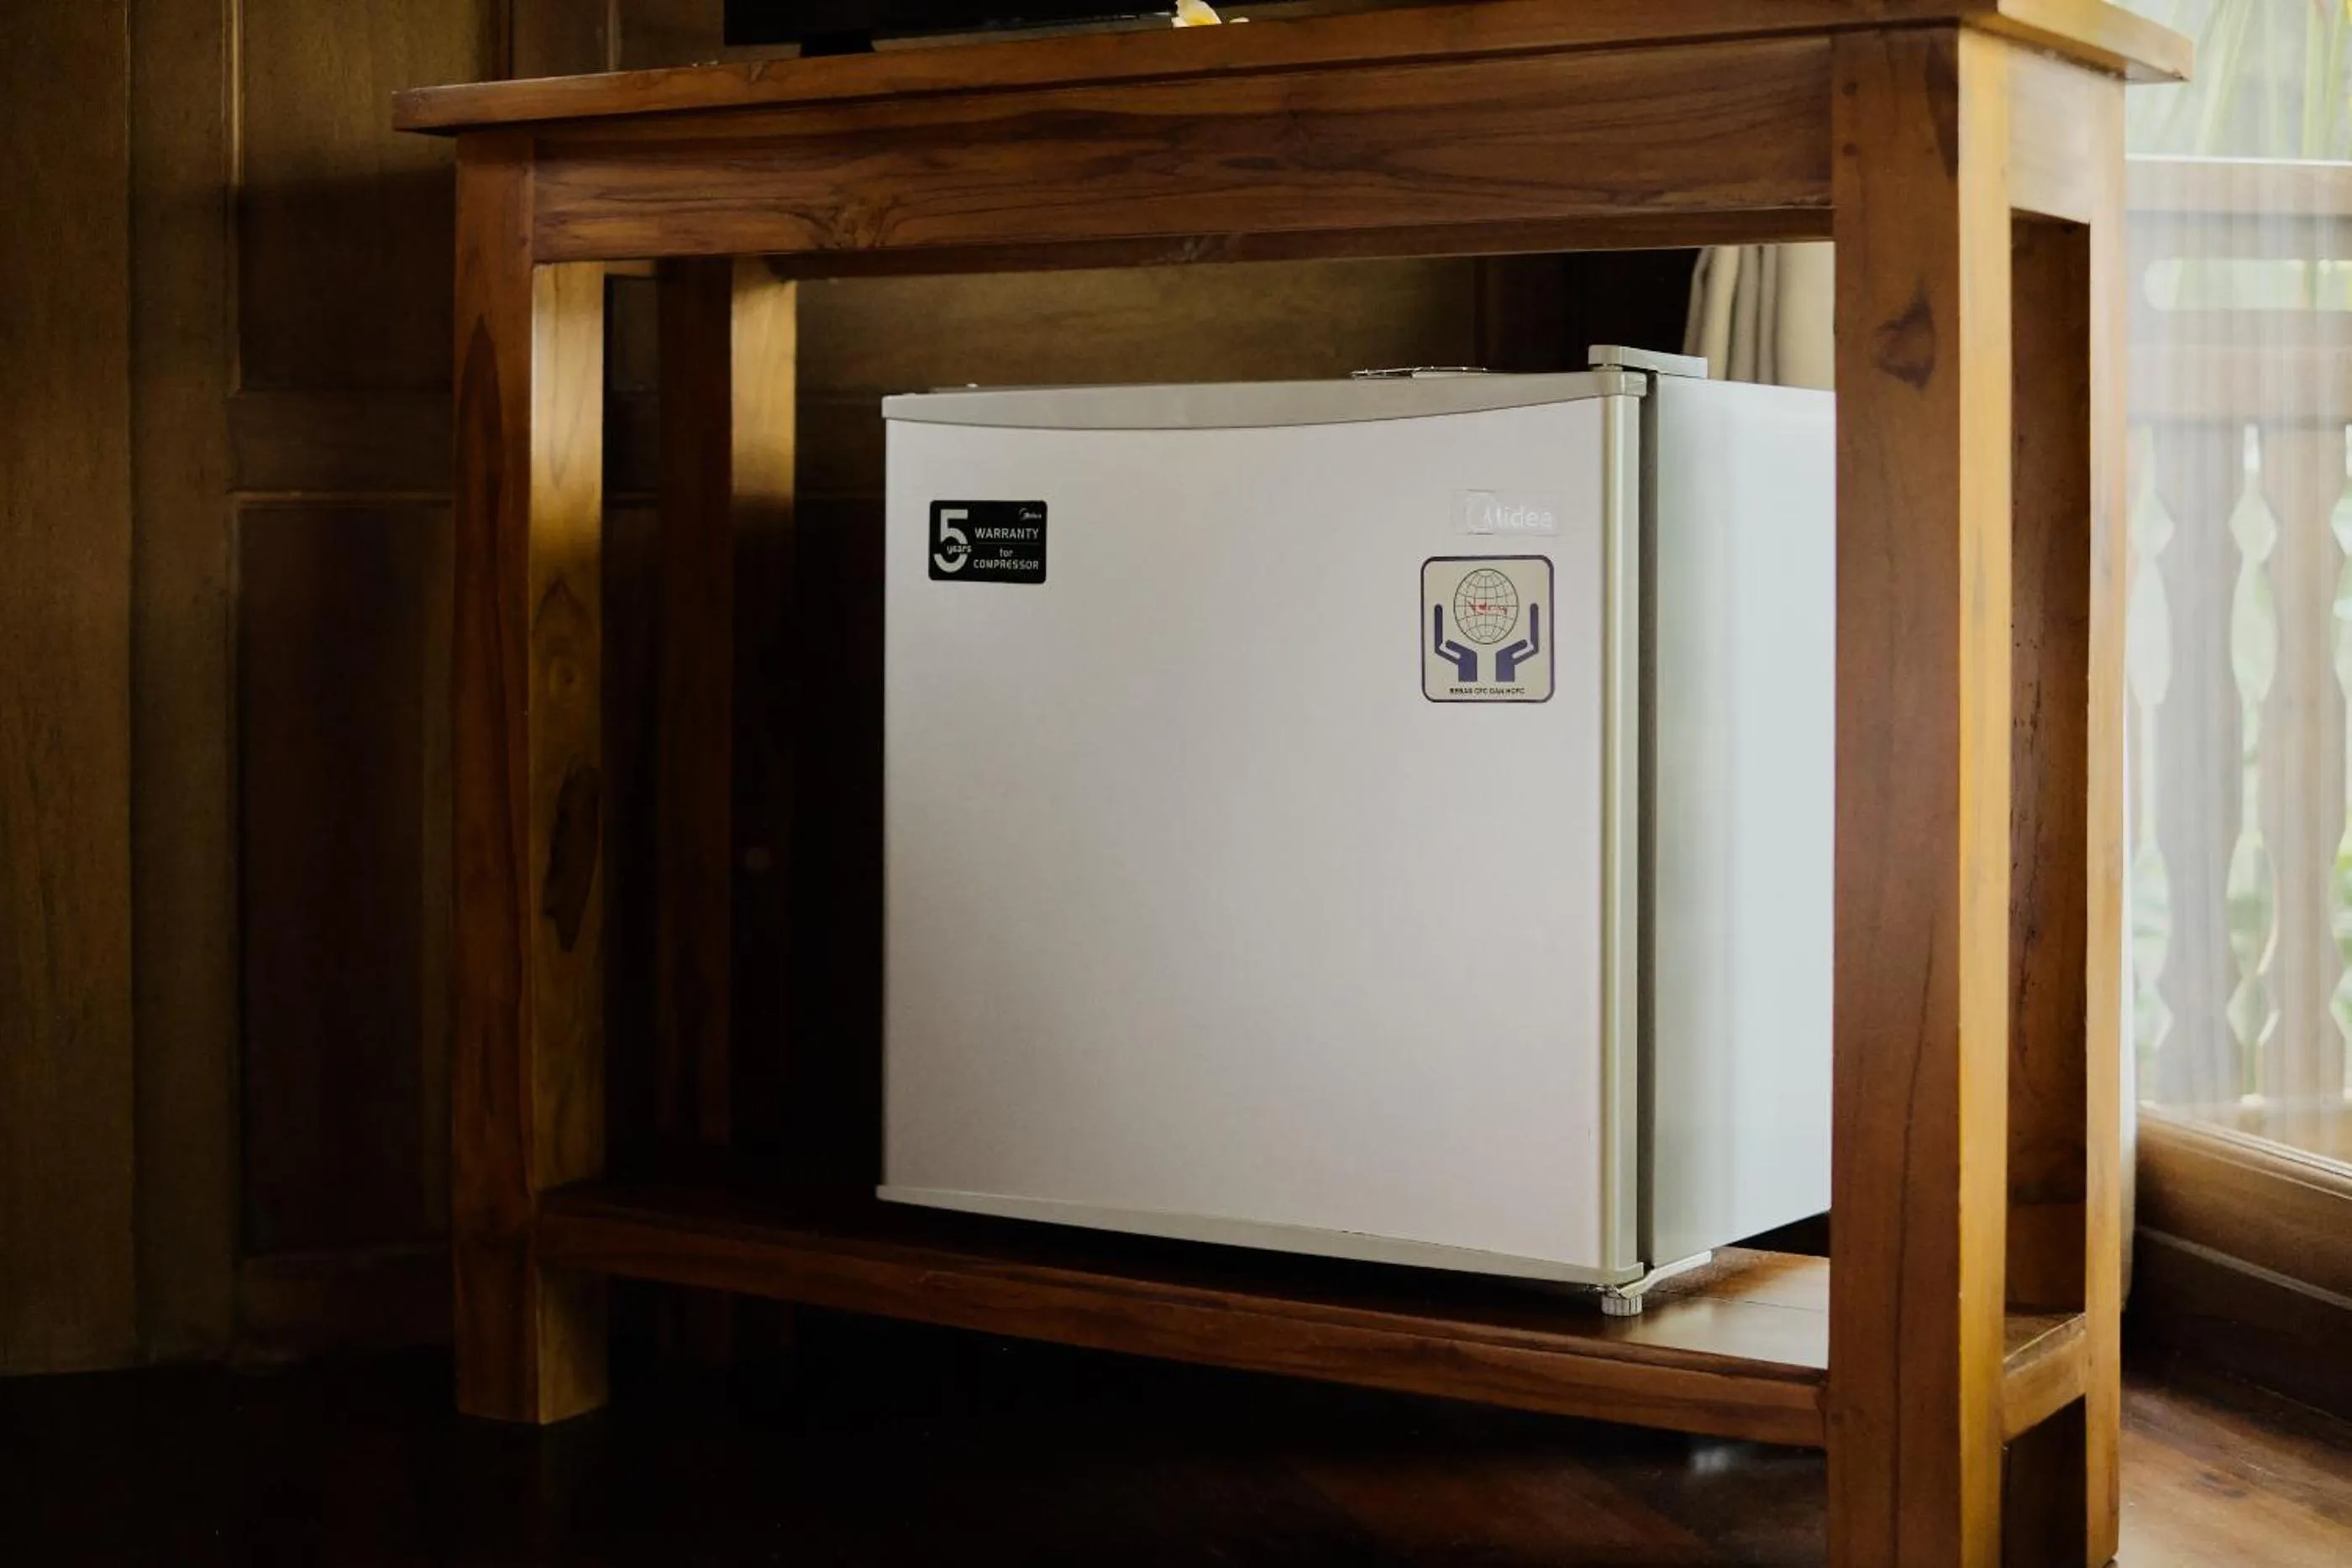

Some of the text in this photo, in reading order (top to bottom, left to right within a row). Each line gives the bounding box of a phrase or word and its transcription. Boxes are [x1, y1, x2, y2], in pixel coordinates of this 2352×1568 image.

[974, 527, 1039, 539] WARRANTY
[933, 509, 969, 573] 5
[947, 545, 972, 554] years
[1000, 548, 1013, 557] for
[973, 559, 1039, 570] COMPRESSOR
